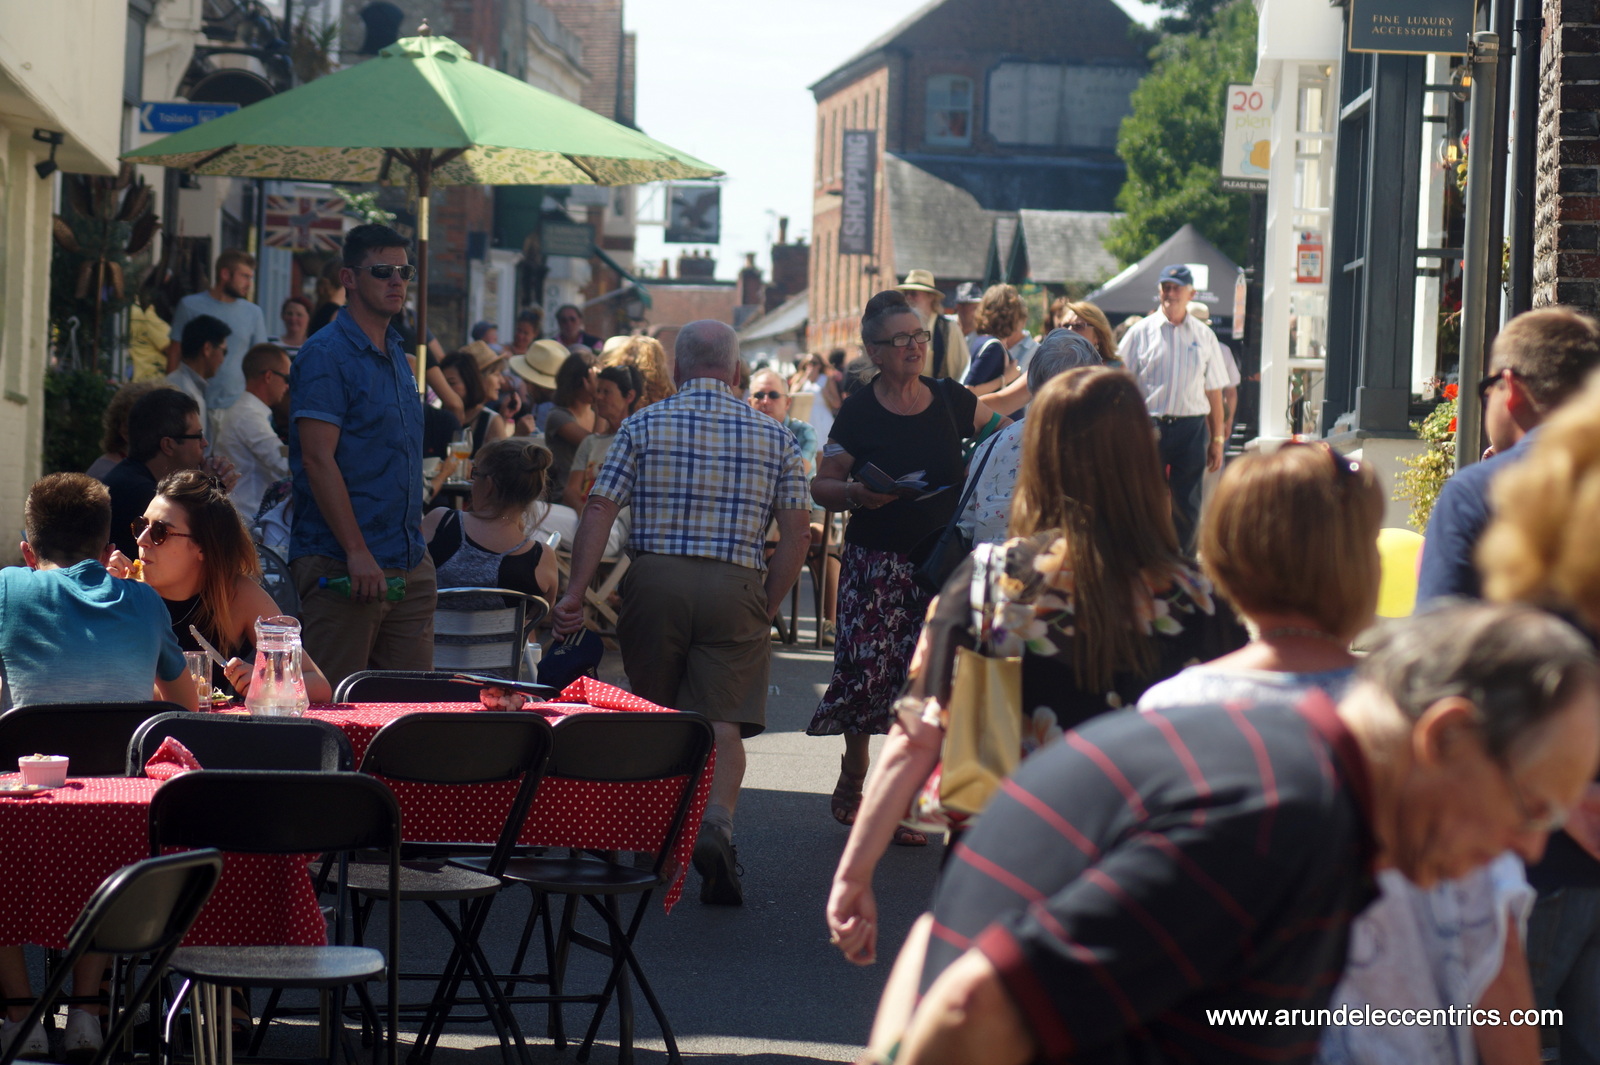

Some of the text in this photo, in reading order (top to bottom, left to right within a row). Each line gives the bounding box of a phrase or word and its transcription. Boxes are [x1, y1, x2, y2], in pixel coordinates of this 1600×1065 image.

[1372, 14, 1455, 26] FINE LUXURY
[1371, 26, 1454, 37] ACCESSORIES
[1232, 91, 1264, 111] 20
[159, 112, 194, 123] Toilets
[842, 134, 869, 236] SHOPPING
[1223, 180, 1267, 191] PLEASE SLOW
